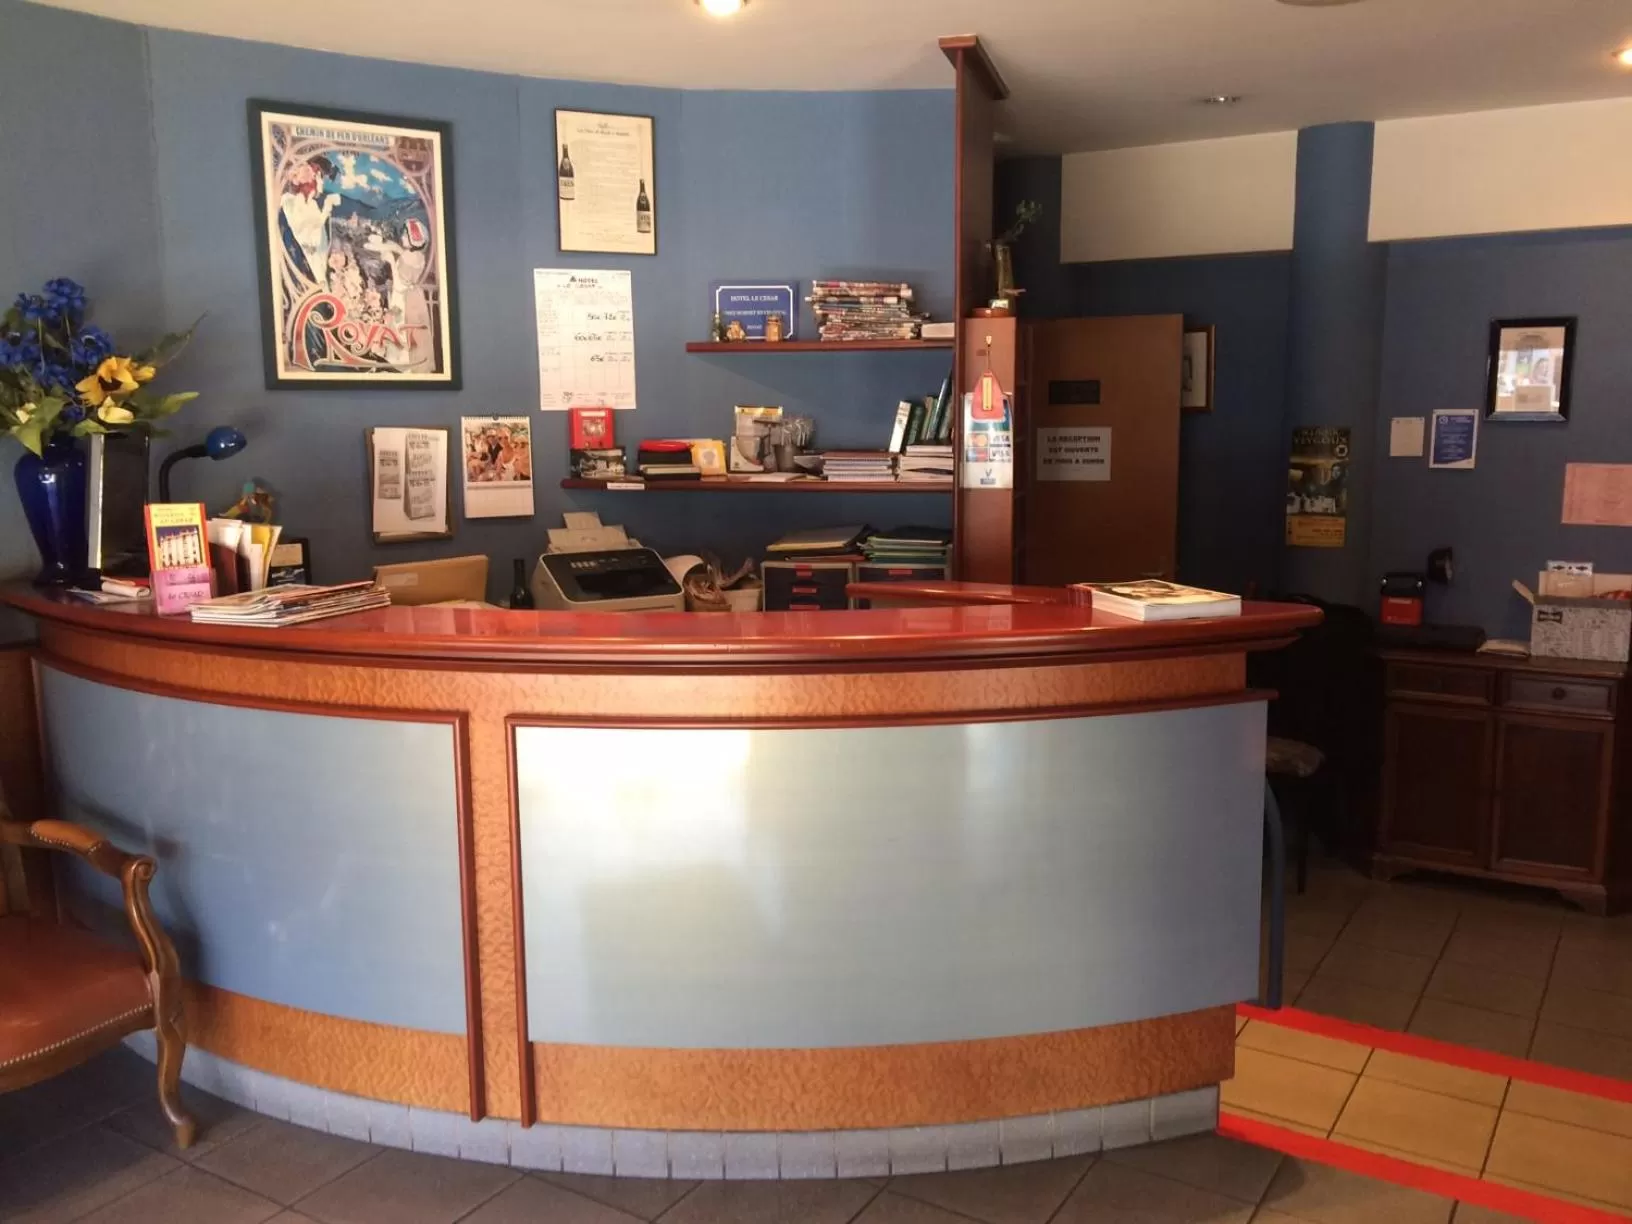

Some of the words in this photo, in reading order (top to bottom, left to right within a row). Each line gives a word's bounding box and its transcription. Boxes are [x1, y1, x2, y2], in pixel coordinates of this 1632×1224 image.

[295, 126, 325, 138] CHEMIN
[326, 129, 334, 139] DE
[336, 130, 350, 142] FER
